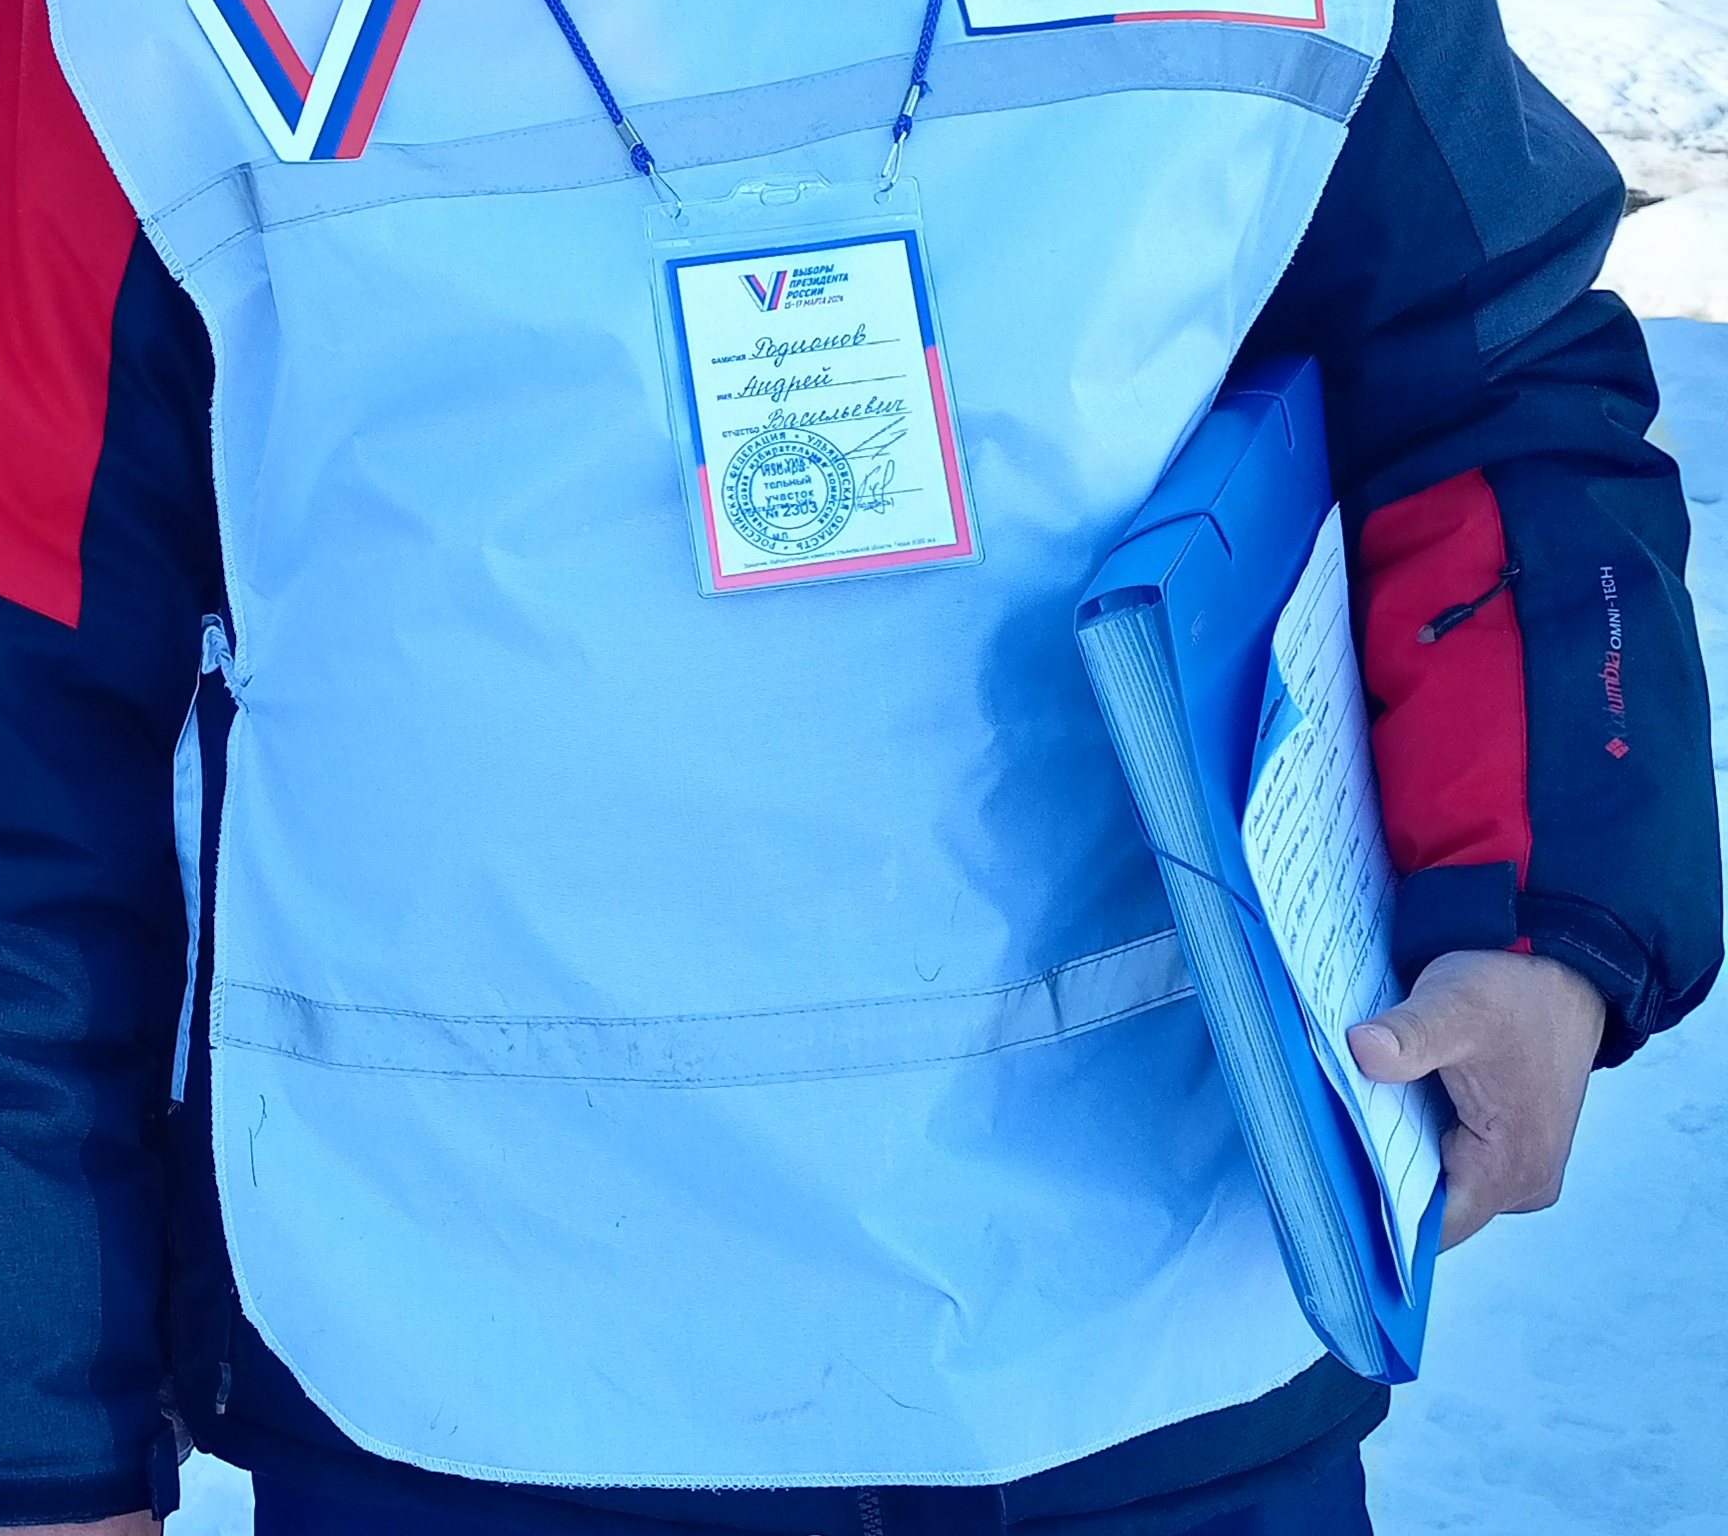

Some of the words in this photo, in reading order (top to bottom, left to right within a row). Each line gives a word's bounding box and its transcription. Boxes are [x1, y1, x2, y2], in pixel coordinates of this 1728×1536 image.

[789, 273, 849, 289] ПРЕЗИДЕНТА
[792, 264, 834, 277] ВЫБОРЫ
[786, 287, 824, 300] РОССИИ
[752, 323, 866, 367] Родионов
[737, 367, 833, 403] Андрей
[763, 396, 908, 430] Васильевич
[763, 475, 812, 490] тельный
[796, 515, 844, 551] ОБЛАСТЬ
[1599, 565, 1623, 650] OMNI-TECH
